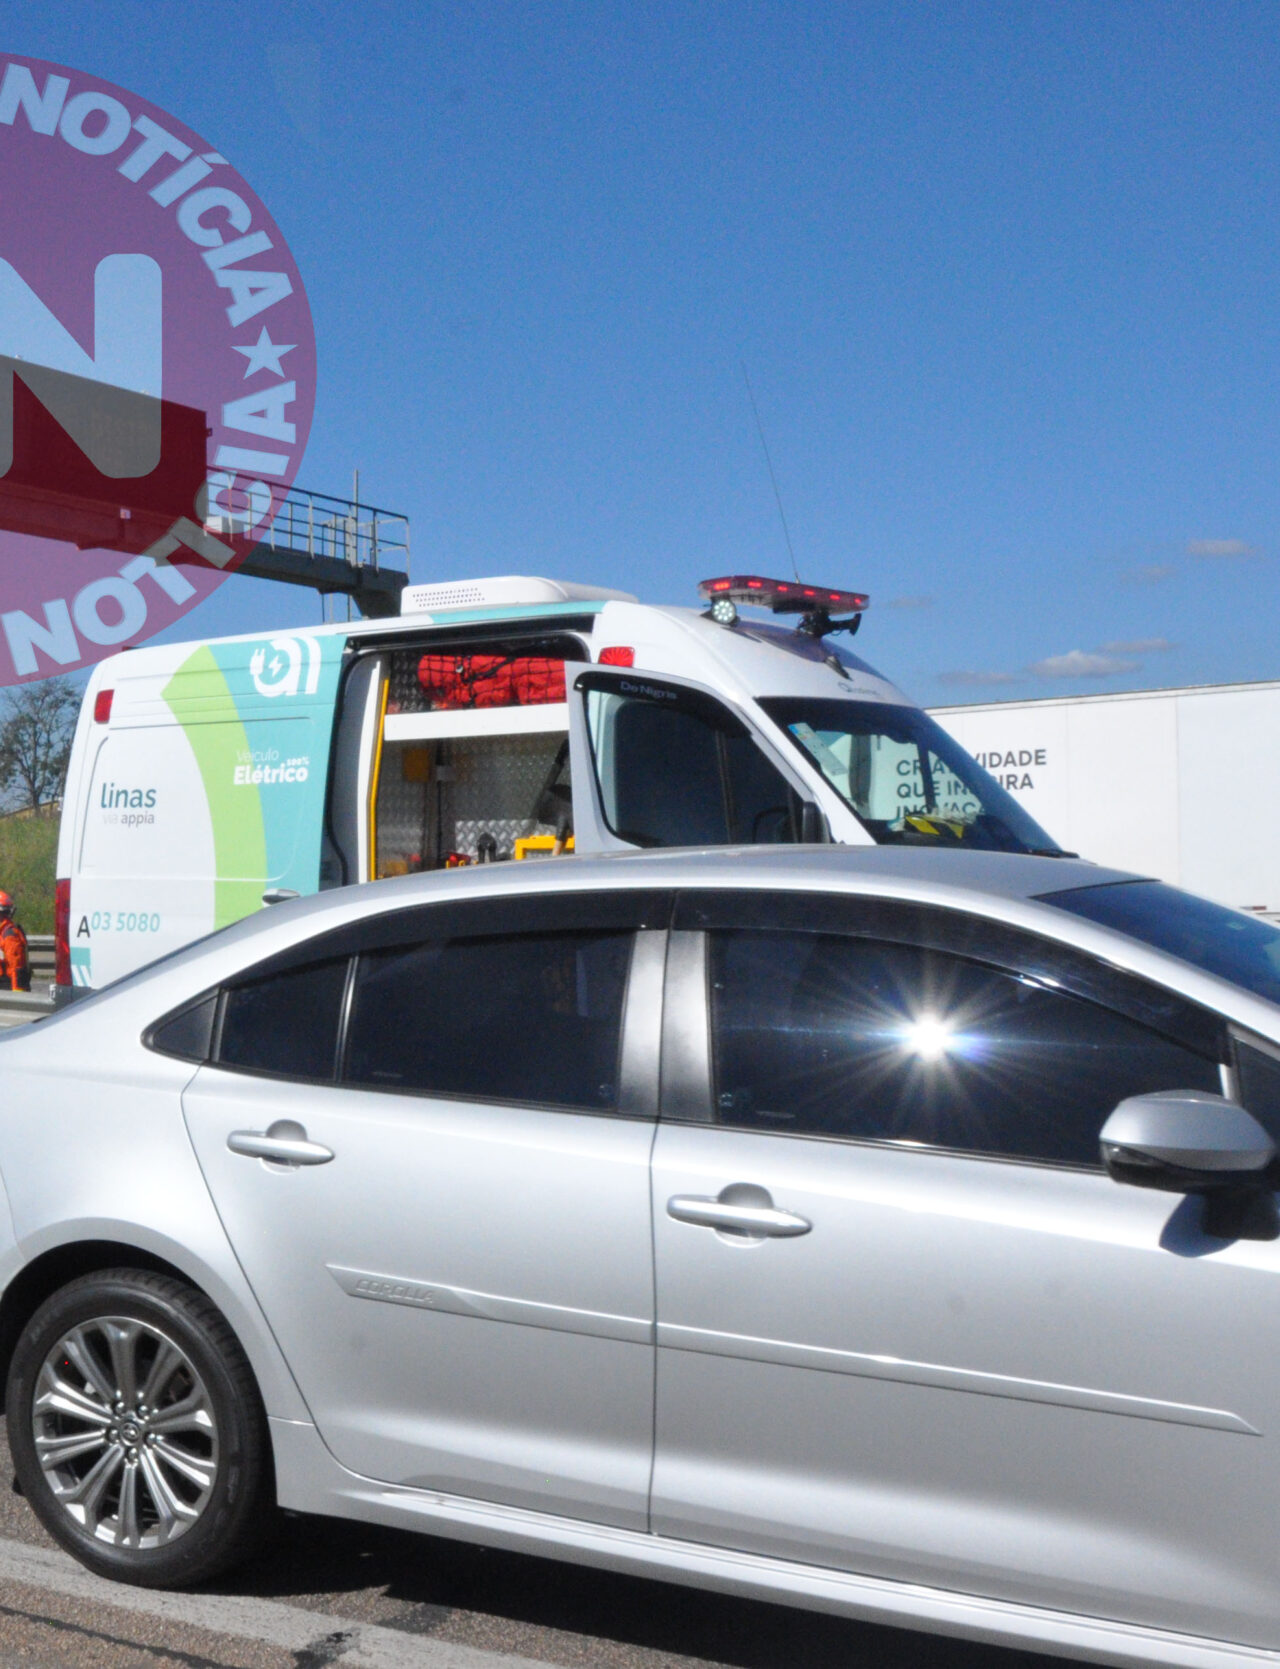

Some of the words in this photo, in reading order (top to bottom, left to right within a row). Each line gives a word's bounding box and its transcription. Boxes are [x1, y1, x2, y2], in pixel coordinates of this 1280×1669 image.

[233, 763, 309, 785] Elétrico
[100, 782, 157, 809] linas
[121, 810, 155, 828] appia
[76, 915, 91, 939] A
[90, 911, 112, 931] 03
[115, 911, 161, 933] 5080
[355, 1279, 434, 1304] COROLLA
